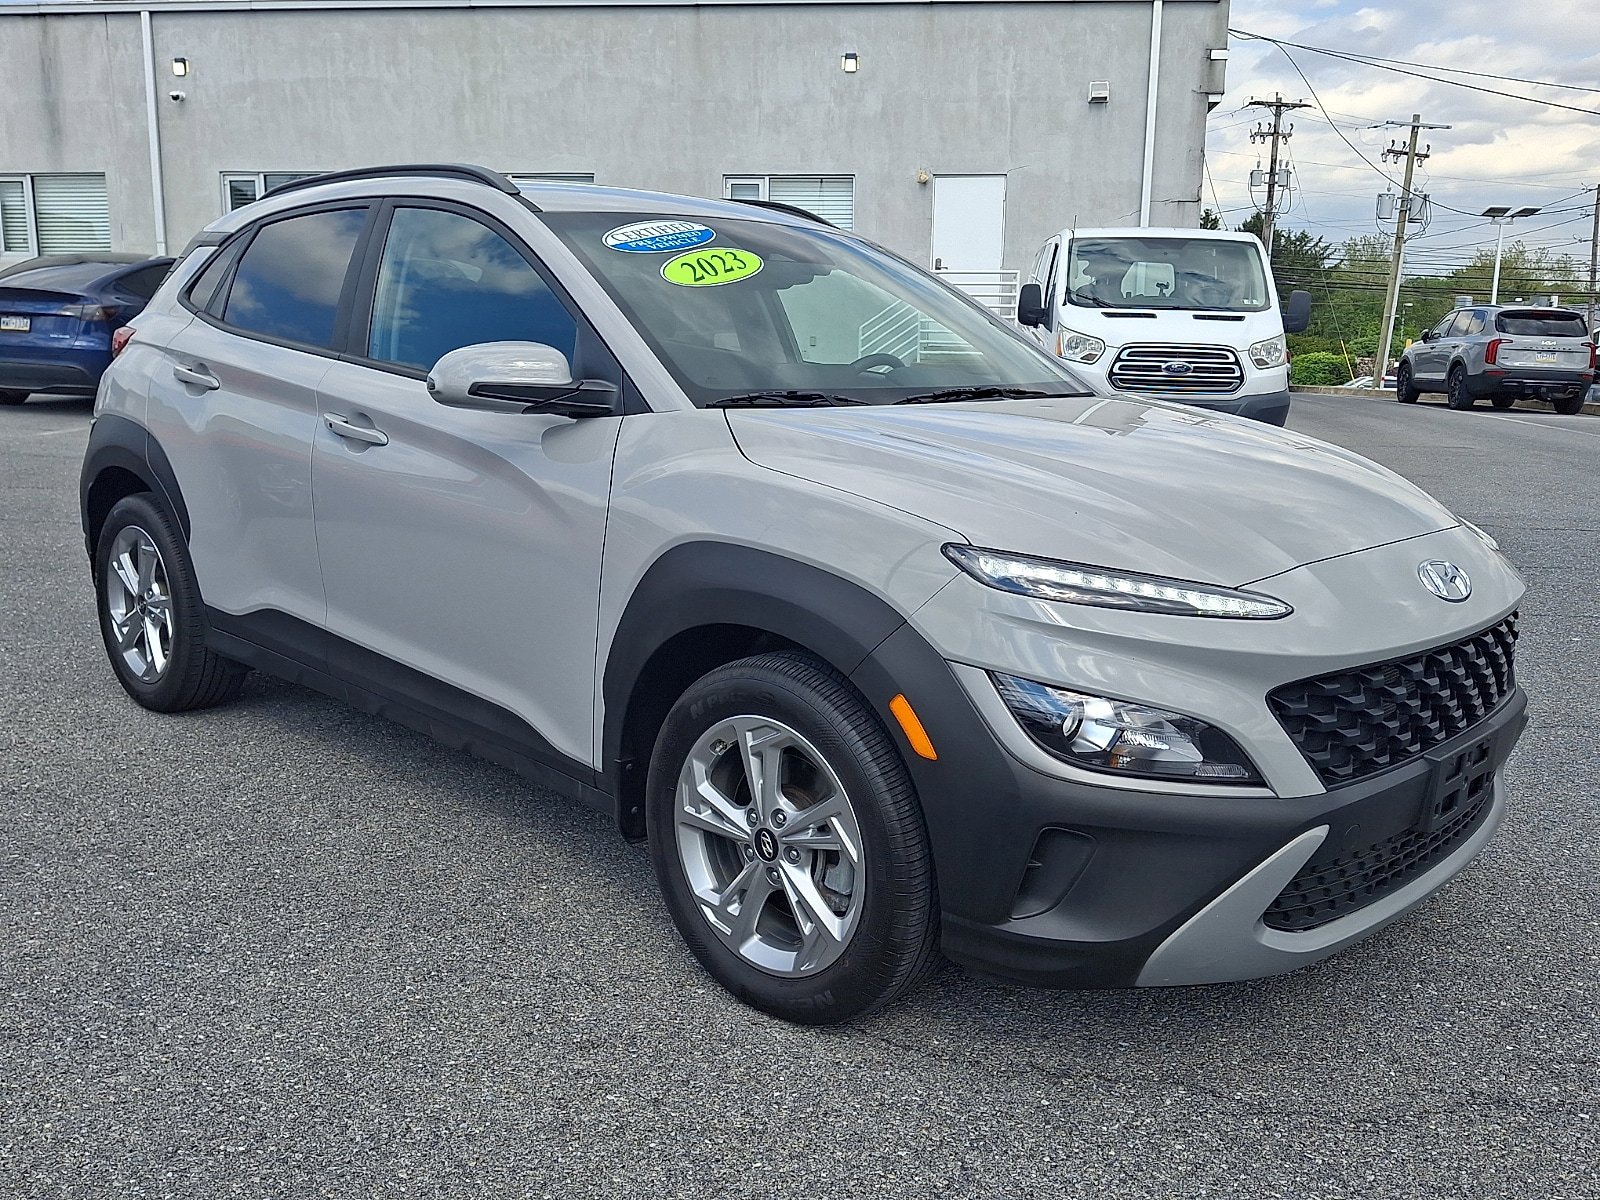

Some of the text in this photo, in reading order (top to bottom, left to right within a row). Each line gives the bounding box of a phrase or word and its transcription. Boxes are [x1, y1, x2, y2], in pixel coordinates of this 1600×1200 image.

[611, 222, 696, 242] CERTIFIED
[629, 230, 702, 248] PRE-OWNED
[646, 237, 702, 250] VEHICLE
[680, 252, 747, 283] 2023
